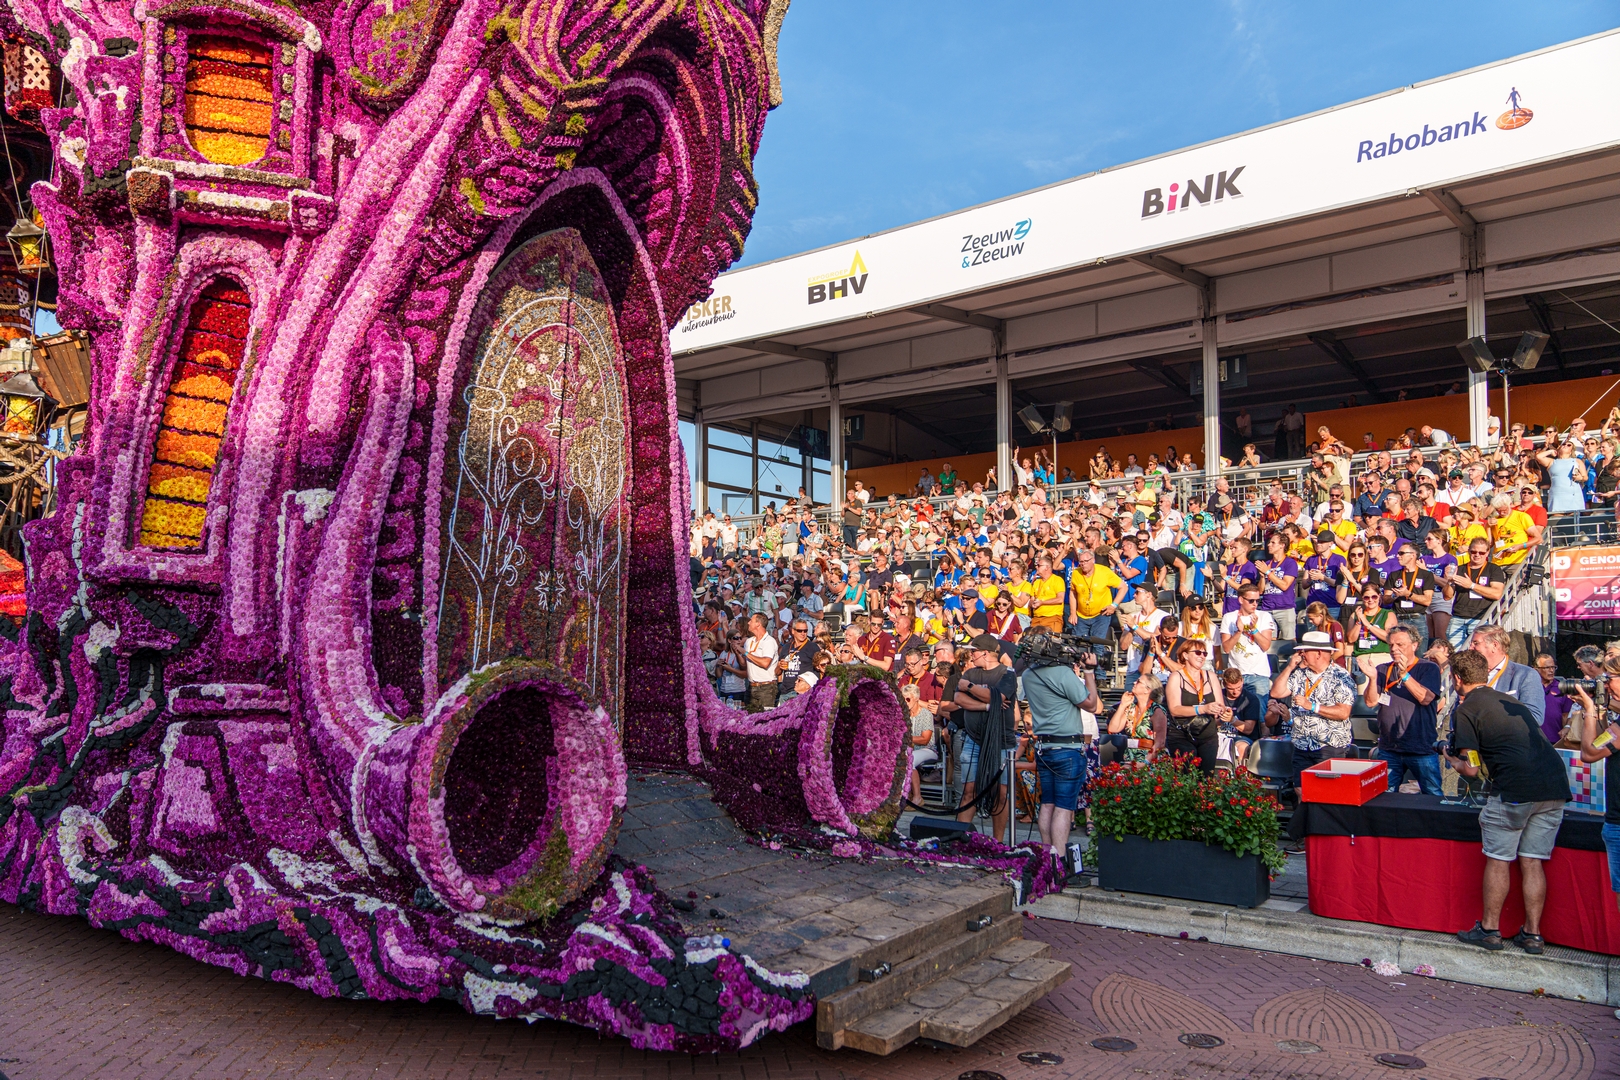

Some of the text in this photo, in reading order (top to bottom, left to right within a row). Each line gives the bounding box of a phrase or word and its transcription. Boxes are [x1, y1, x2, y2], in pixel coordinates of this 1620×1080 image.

[1356, 111, 1488, 163] Rabobank
[961, 228, 1014, 253] Zeeuw
[961, 241, 1025, 269] &Zeeuw
[808, 269, 848, 282] EXPOGROEP
[808, 273, 869, 305] BHV
[679, 295, 732, 323] ISKER
[681, 309, 737, 333] interieurbouw
[1593, 585, 1620, 594] LE S
